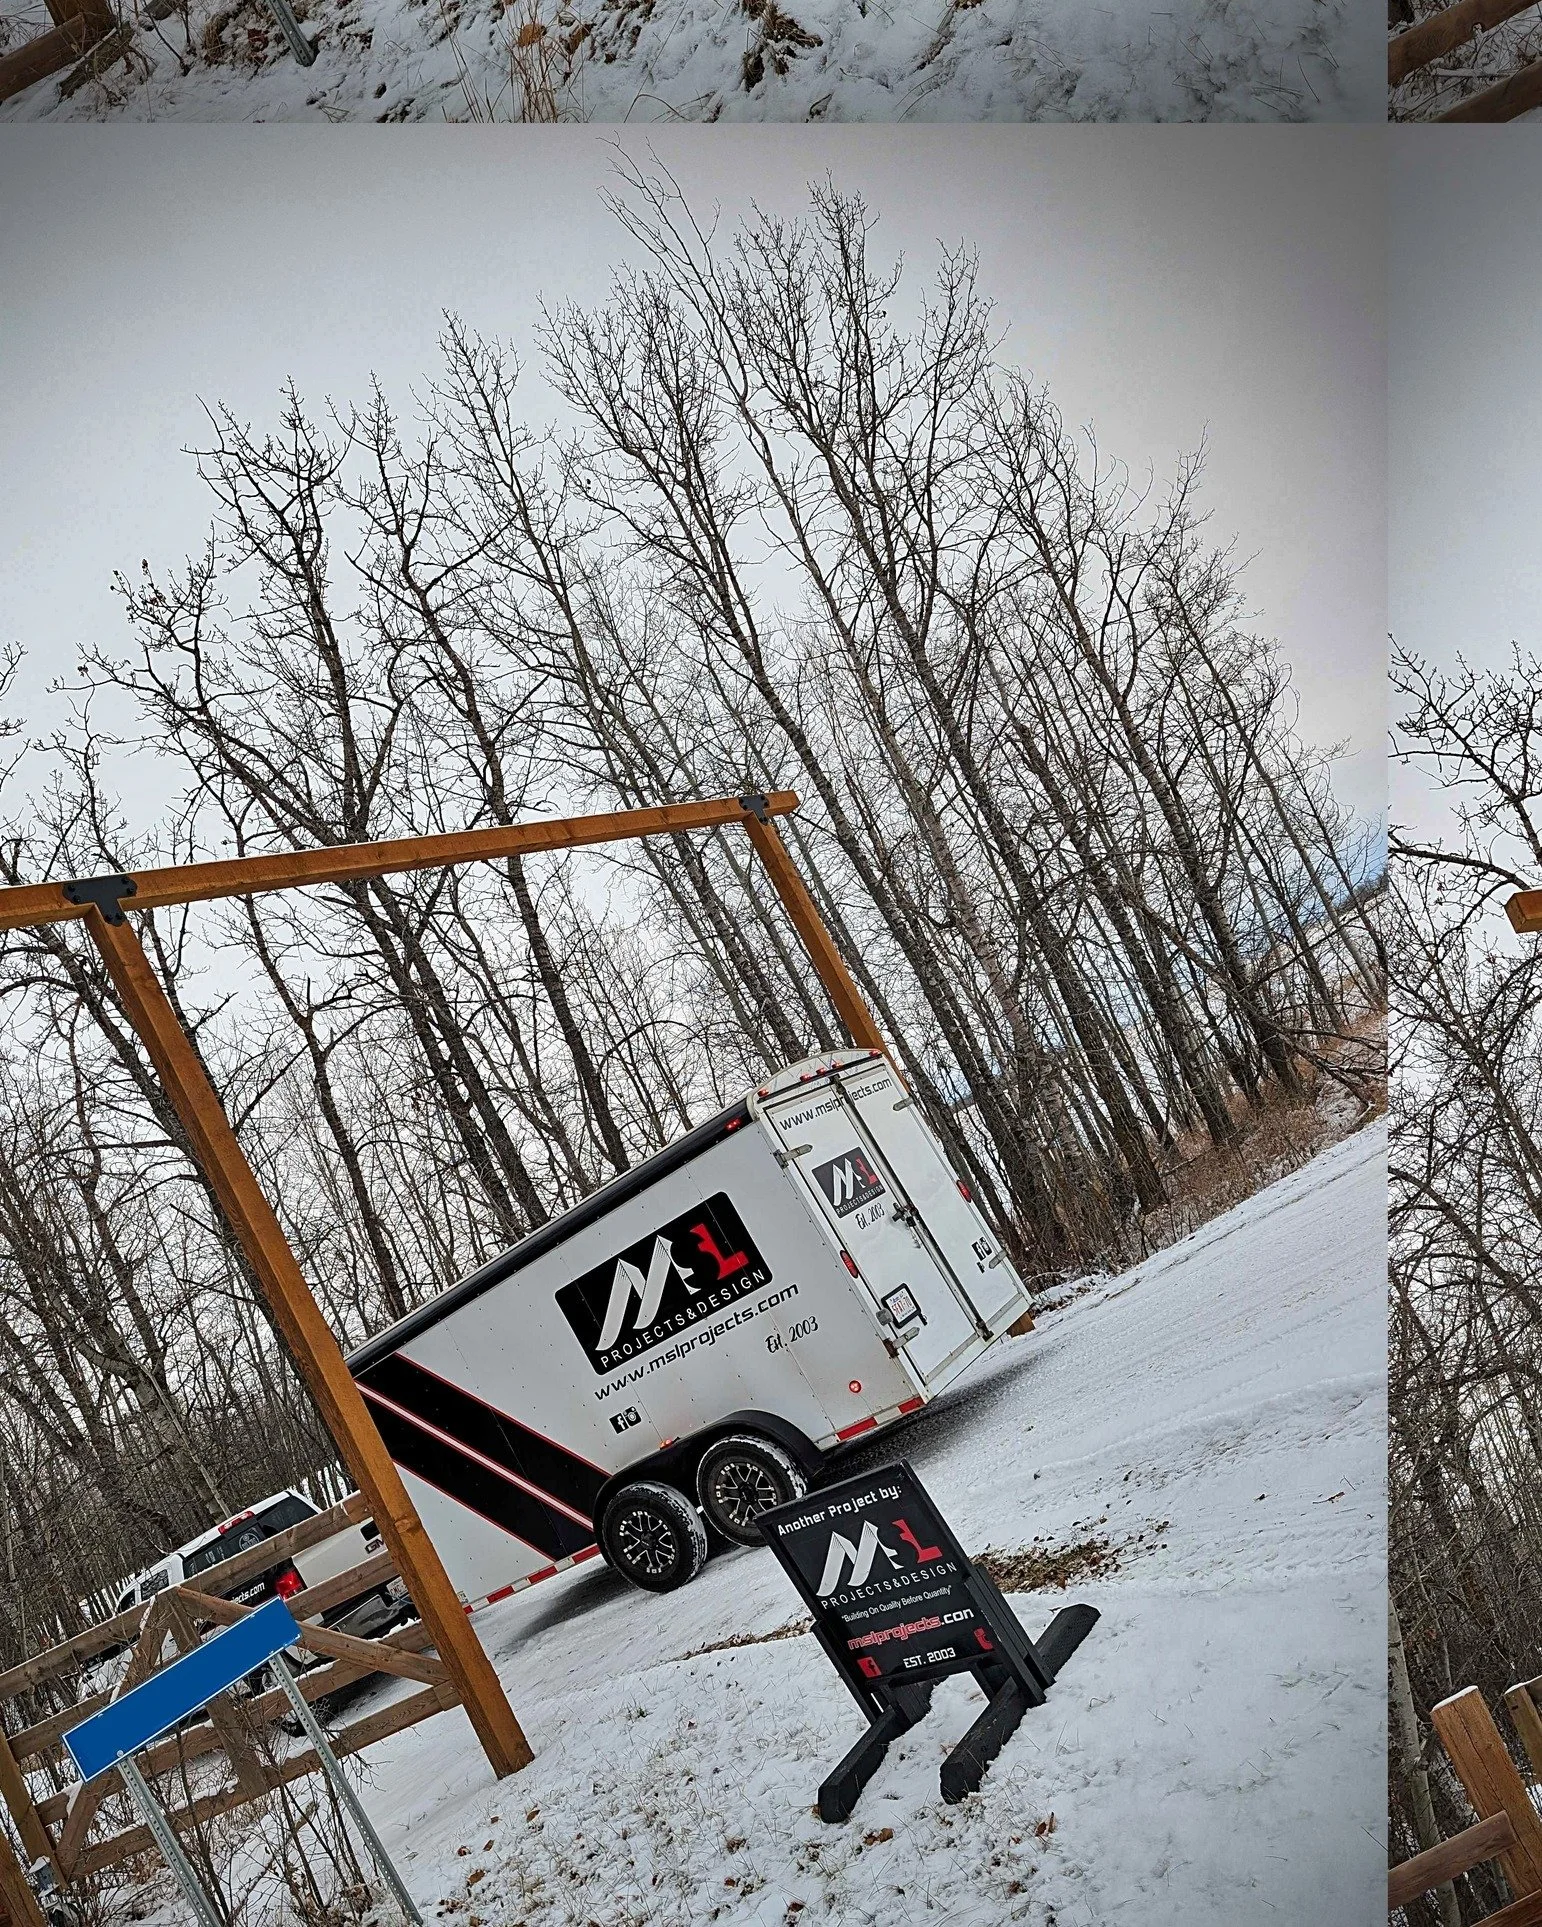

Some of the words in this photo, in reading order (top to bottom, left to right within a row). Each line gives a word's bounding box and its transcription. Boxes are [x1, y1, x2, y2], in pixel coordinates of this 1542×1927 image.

[780, 1079, 892, 1130] www.mslprjects.com
[868, 1202, 885, 1222] 2003
[594, 1283, 799, 1400] www.mslprojects.com
[601, 1269, 765, 1368] PROJECTS&DESIGN
[765, 1333, 788, 1353] Est.
[788, 1315, 819, 1343] 2003
[777, 1511, 826, 1536] Another
[828, 1490, 878, 1518] Project
[879, 1485, 902, 1500] by:
[821, 1562, 957, 1610] PROJECTS&DESIGN
[870, 1606, 879, 1615] On
[879, 1599, 901, 1612] Quality
[901, 1594, 923, 1606] Before
[903, 1655, 926, 1669] EST.
[926, 1647, 956, 1664] 2003
